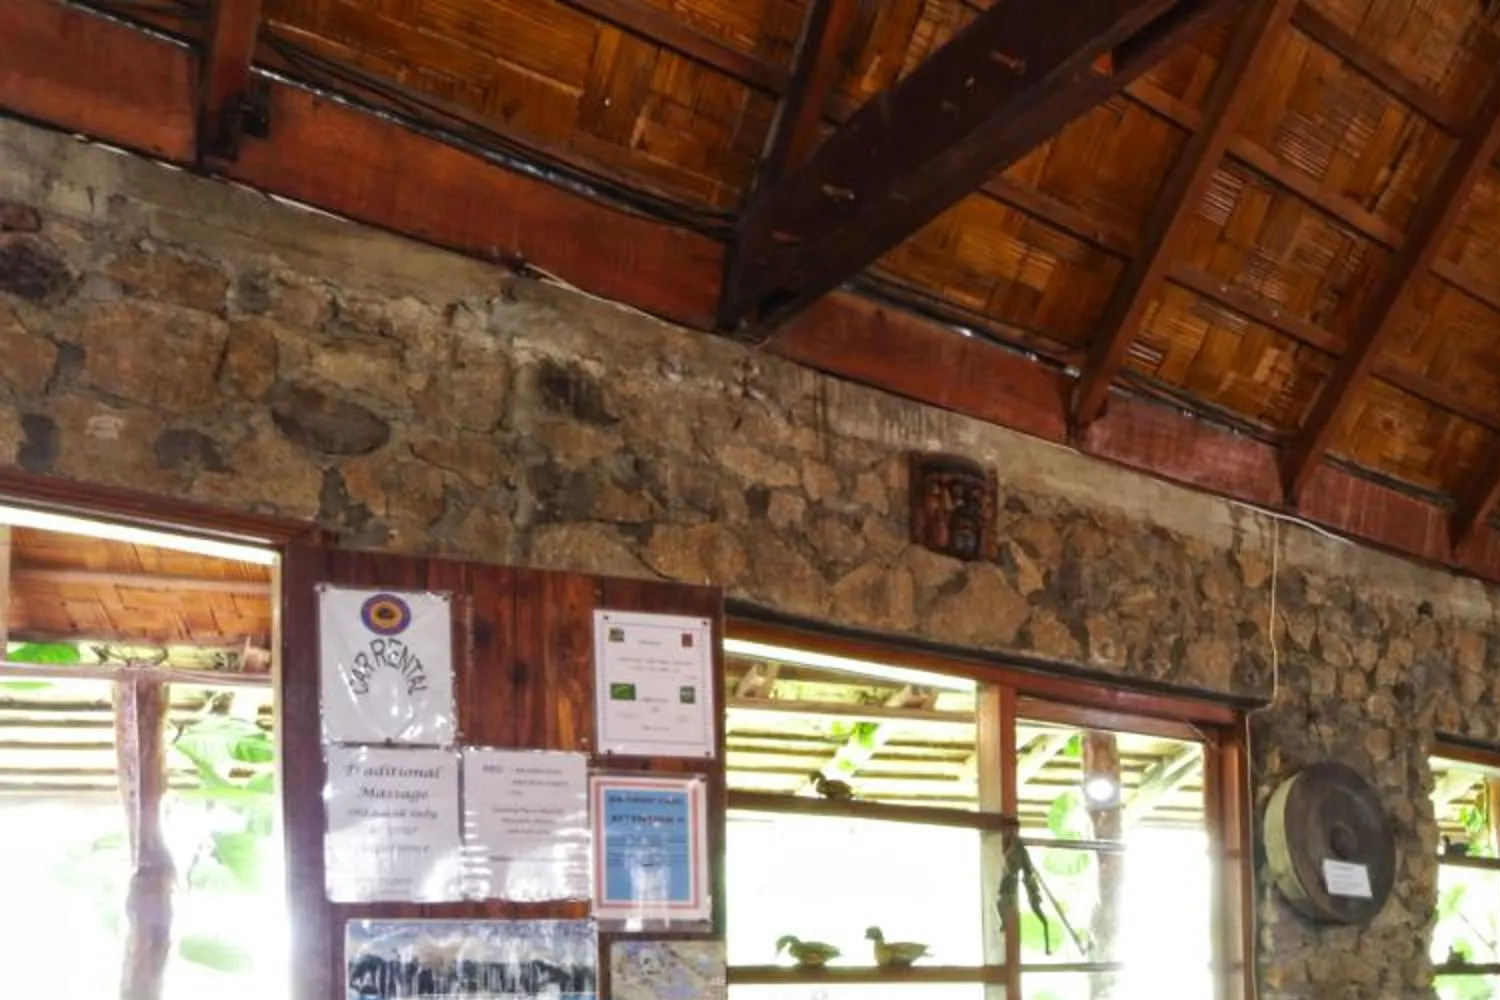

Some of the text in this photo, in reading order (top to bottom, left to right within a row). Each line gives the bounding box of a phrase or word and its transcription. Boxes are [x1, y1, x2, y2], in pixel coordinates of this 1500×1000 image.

[349, 637, 428, 696] CAR RENTAL
[342, 763, 444, 780] Traditional
[356, 786, 430, 804] Massage
